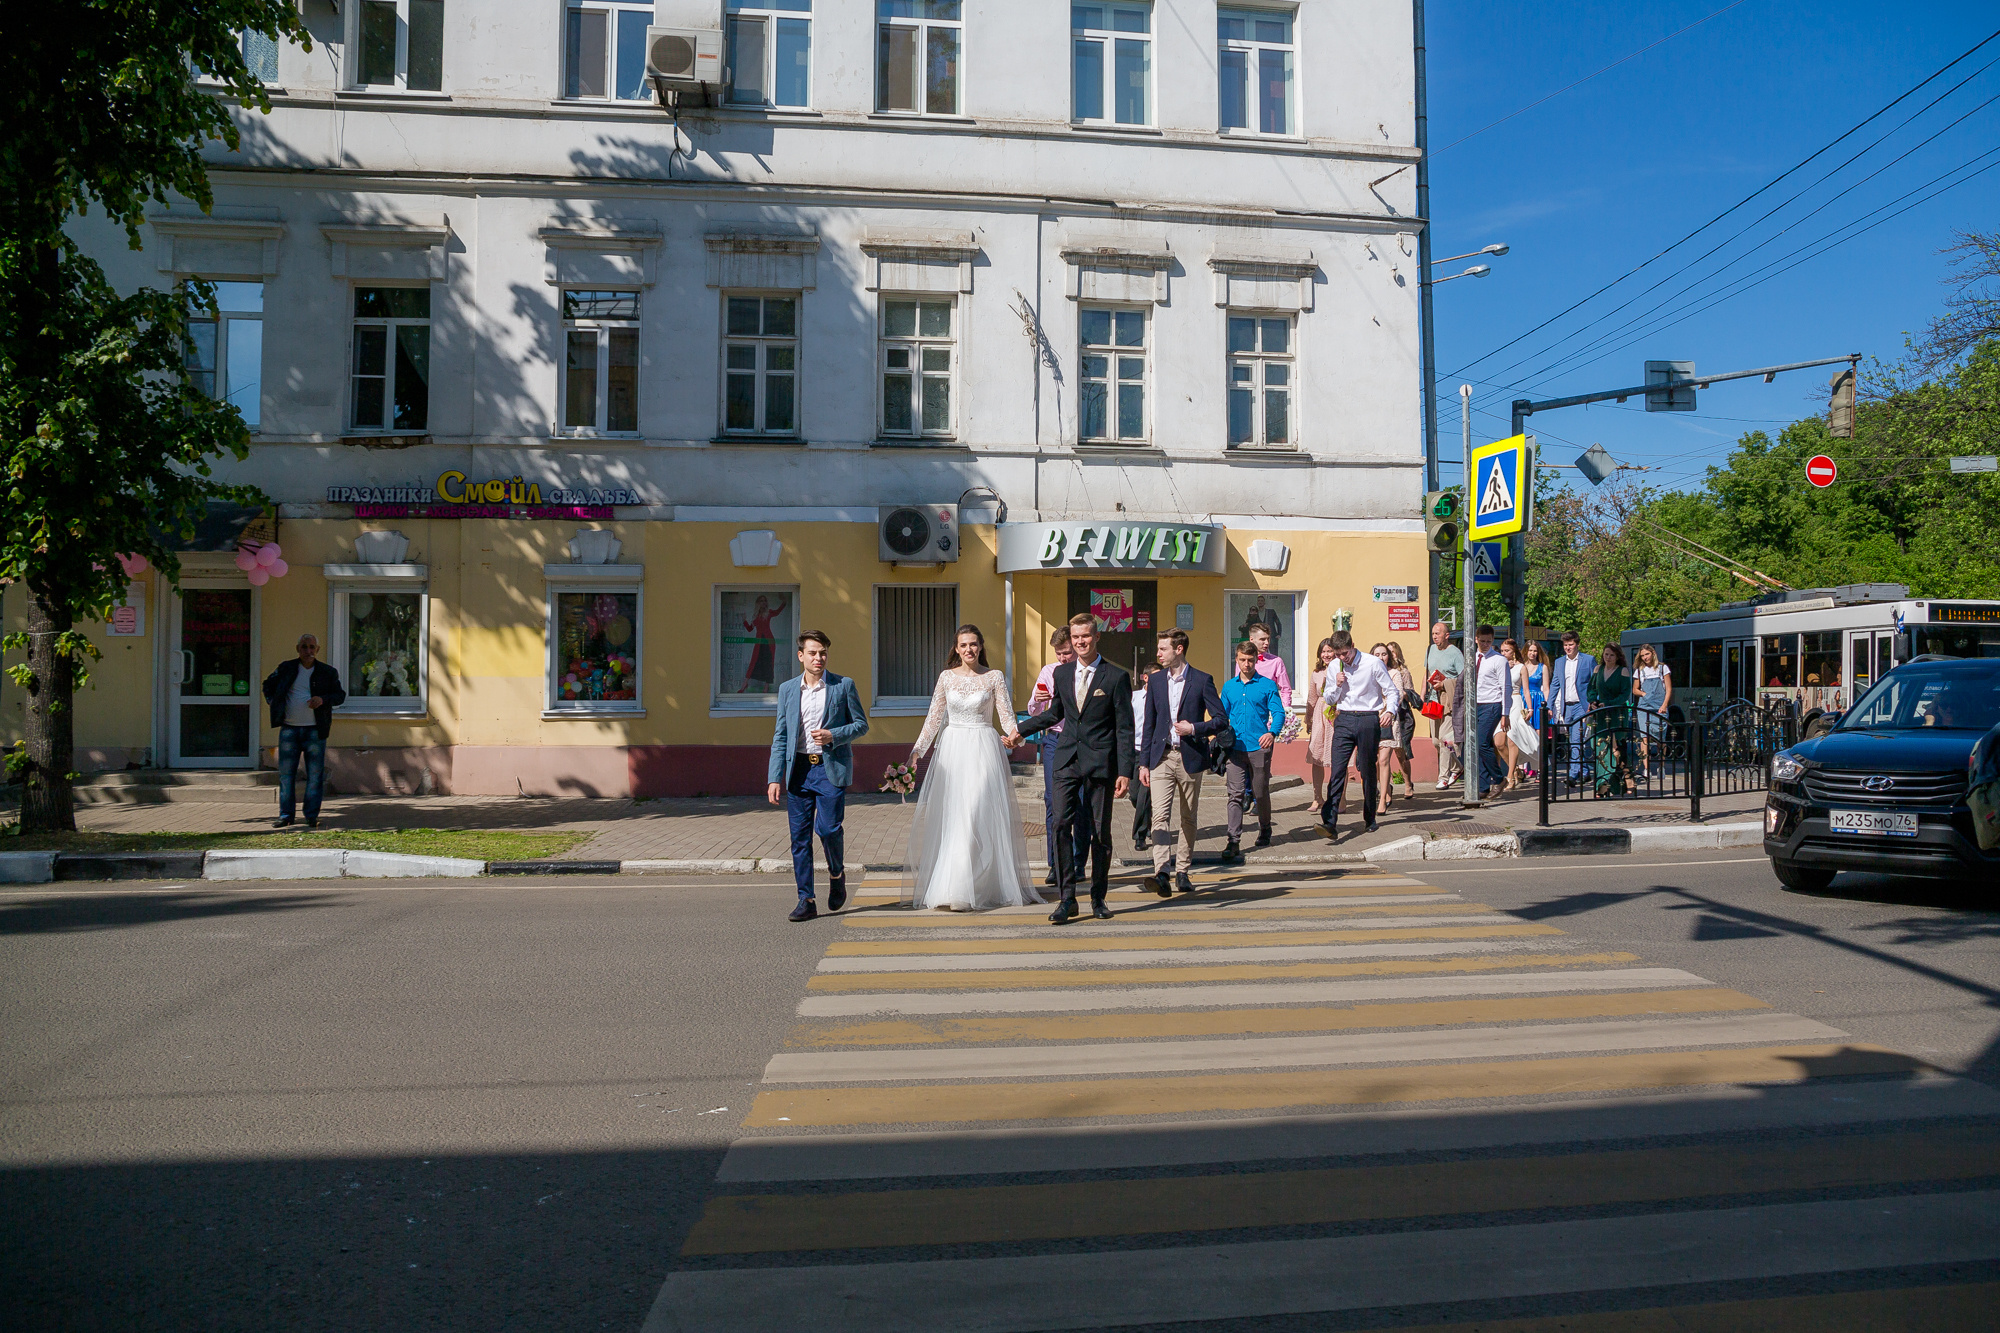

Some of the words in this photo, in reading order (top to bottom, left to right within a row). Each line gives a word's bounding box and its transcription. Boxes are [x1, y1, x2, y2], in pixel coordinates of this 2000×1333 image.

[327, 486, 433, 504] ПРАЗДНИКИ
[549, 488, 641, 506] СВАДЬБА
[354, 505, 409, 518] ШАРИКИ
[425, 506, 510, 518] АКСЕССУАРЫ
[526, 506, 614, 519] ОФОРМЛЕНИЕ
[1036, 526, 1212, 564] BELWEST
[1896, 814, 1912, 826] 76
